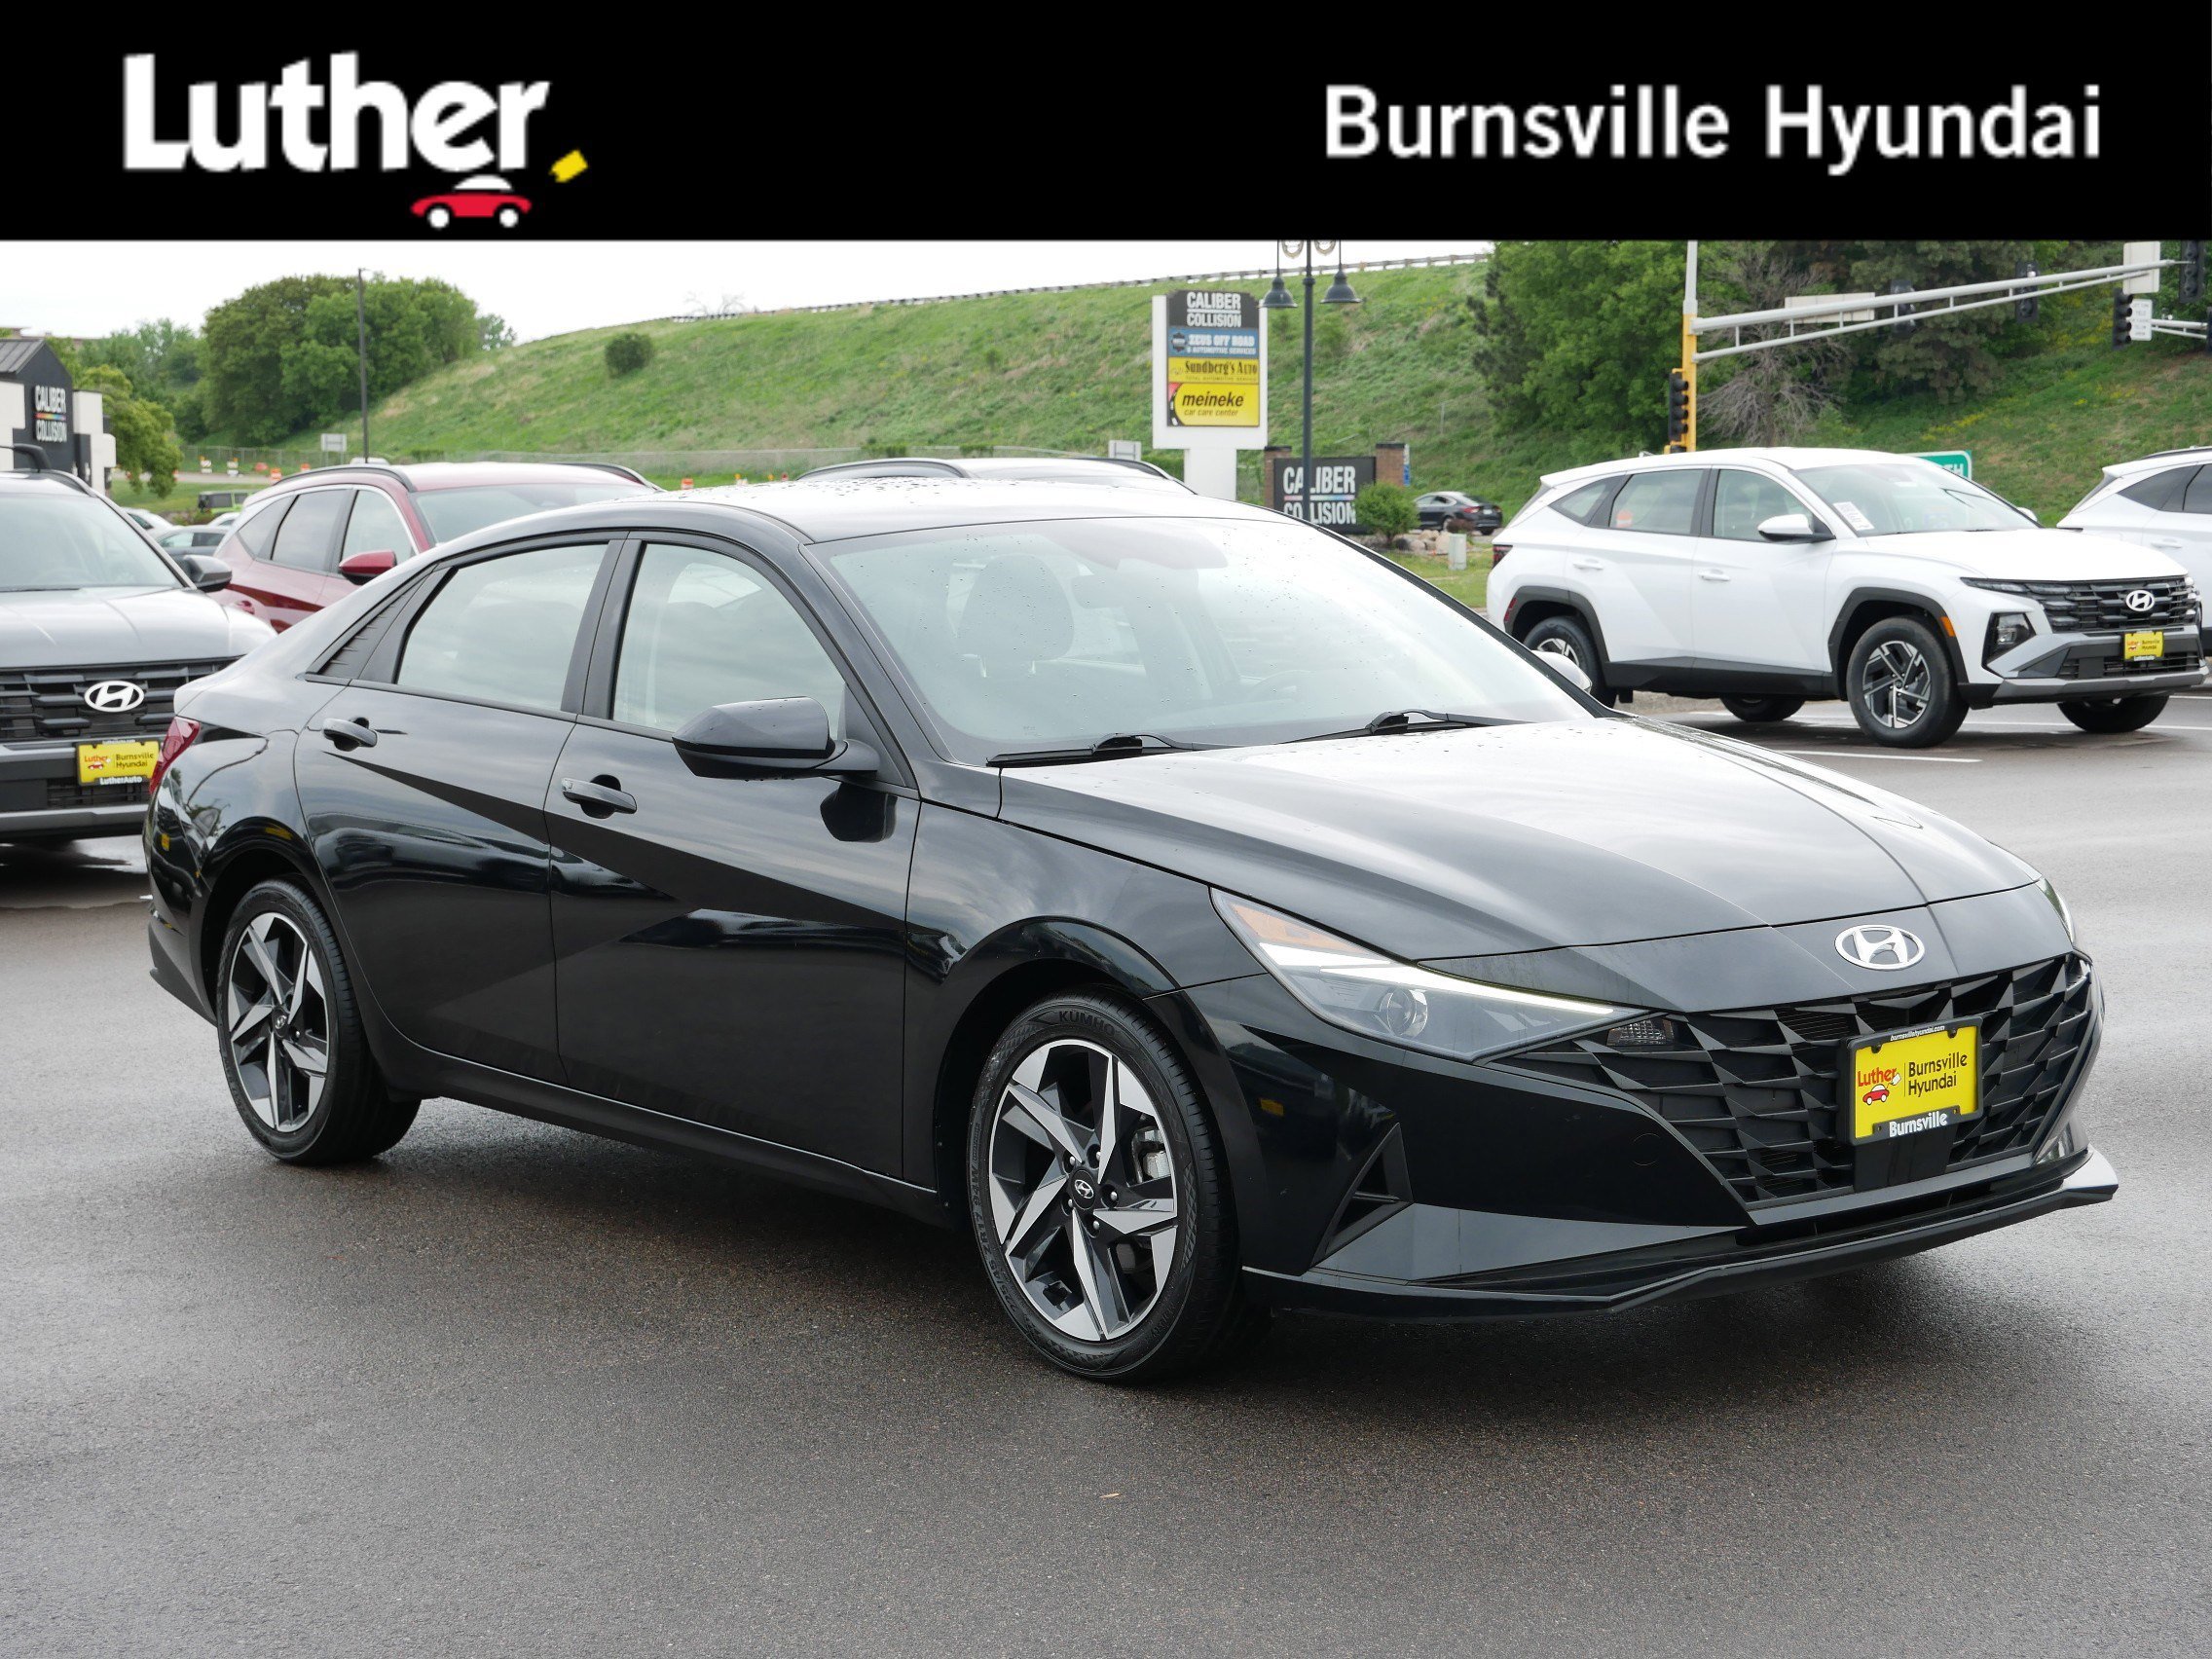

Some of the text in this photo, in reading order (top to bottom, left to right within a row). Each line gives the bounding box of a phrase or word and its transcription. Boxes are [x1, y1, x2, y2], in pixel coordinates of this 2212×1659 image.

[1187, 292, 1241, 309] CALIBER
[1187, 313, 1242, 328] COLLISION
[1185, 360, 1235, 375] Sundberg's
[35, 385, 66, 414] CALIBER
[1182, 391, 1244, 407] meineke
[36, 420, 67, 442] COLLISION
[1283, 466, 1356, 494] CAIBER
[1284, 502, 1356, 525] COLISION
[84, 754, 108, 762] Luther
[116, 752, 154, 761] Burnsville
[116, 760, 147, 770] Hyundai
[1058, 1010, 1116, 1036] KUMHO
[1908, 1051, 1968, 1078] Burnsville
[1857, 1067, 1898, 1088] Luther
[1908, 1071, 1957, 1098] Hyundai
[1889, 1111, 1948, 1138] Burnsville
